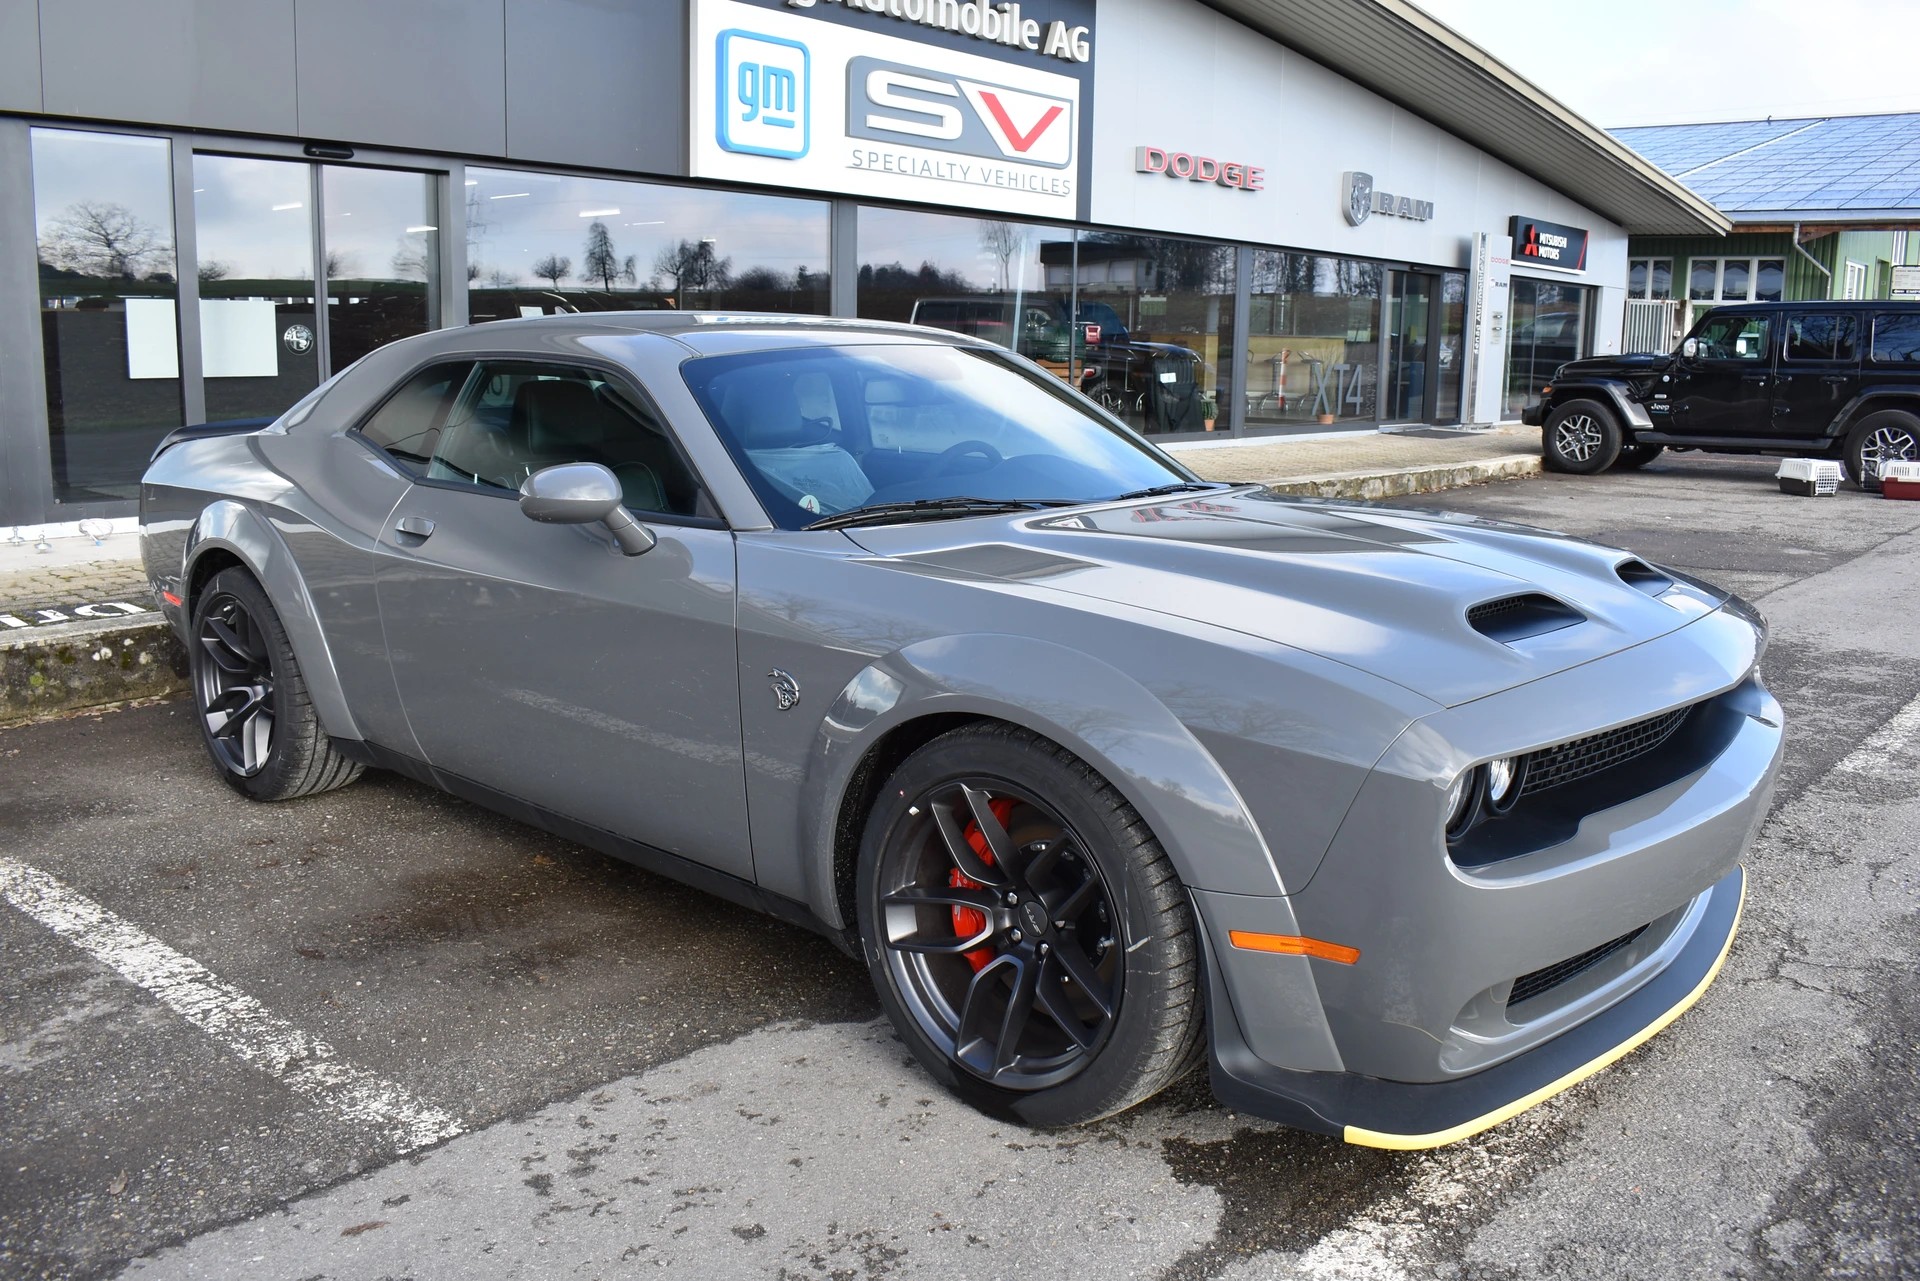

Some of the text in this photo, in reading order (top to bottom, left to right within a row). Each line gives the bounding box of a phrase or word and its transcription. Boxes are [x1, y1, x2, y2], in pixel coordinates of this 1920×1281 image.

[827, 0, 1090, 63] omobile AG
[737, 61, 796, 125] gm
[865, 70, 1065, 152] SV
[851, 149, 1072, 196] SPECIALTY VEHICLES
[1142, 146, 1265, 190] DODGE
[1377, 191, 1434, 220] RAM
[1491, 257, 1510, 265] DODGE
[1538, 246, 1560, 260] MOTORS
[1539, 232, 1567, 248] MITSUBISHI
[1311, 361, 1364, 416] XT4
[1650, 402, 1670, 411] Jeep
